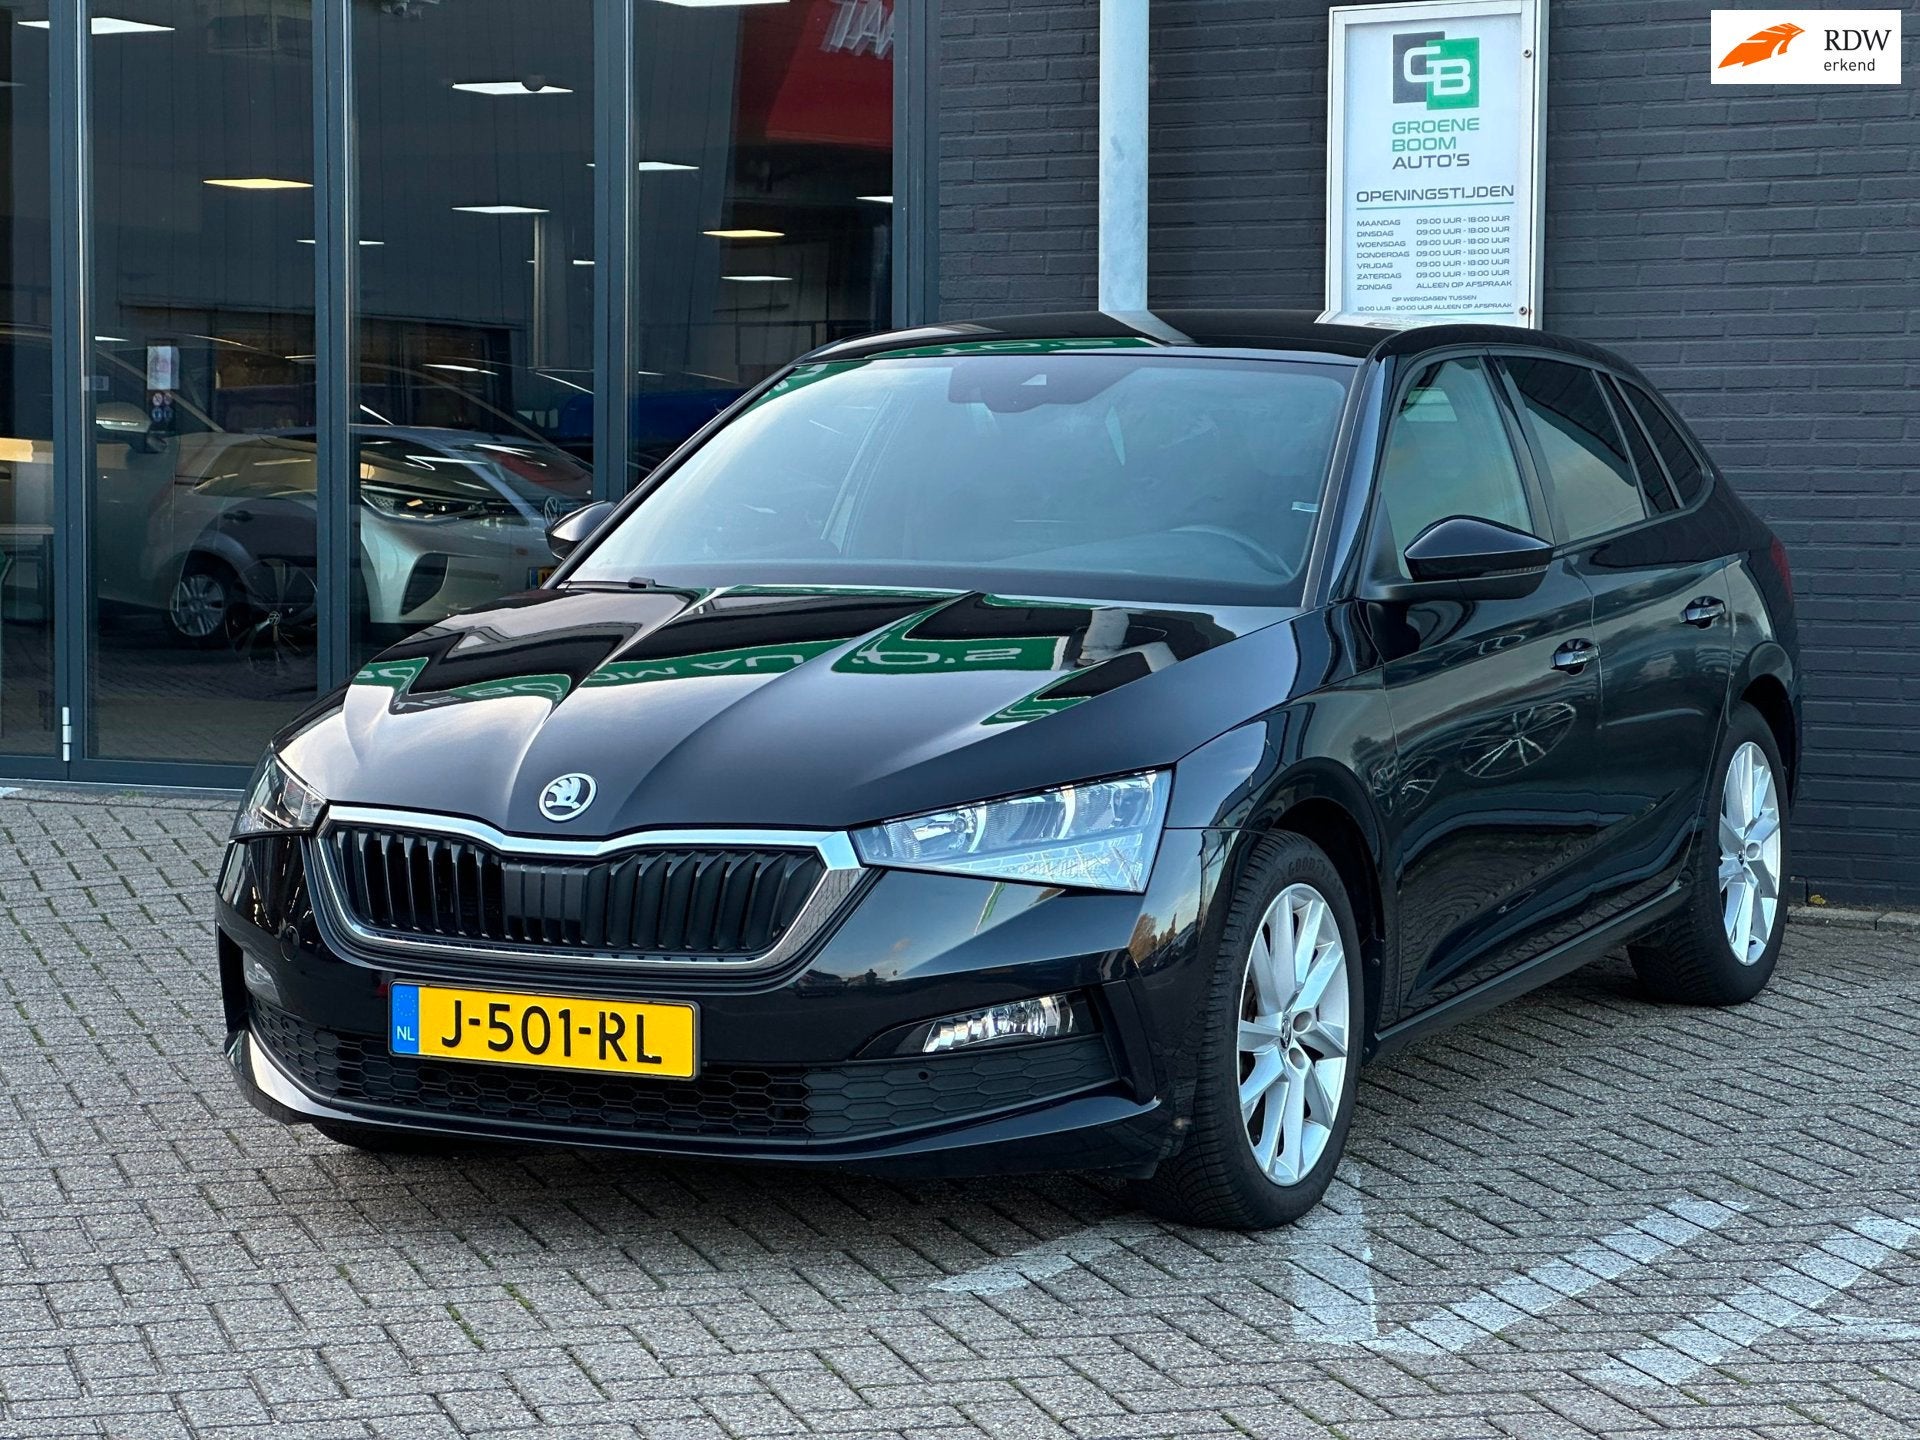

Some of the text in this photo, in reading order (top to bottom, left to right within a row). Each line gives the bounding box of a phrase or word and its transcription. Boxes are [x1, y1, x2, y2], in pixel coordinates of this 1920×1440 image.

[1392, 117, 1480, 135] GROENE
[1392, 136, 1457, 152] BOOM
[1392, 153, 1470, 170] AUTO'S
[1356, 184, 1515, 203] OPENINGSTIJDEN
[1443, 238, 1461, 246] UUR
[1491, 236, 1510, 244] UUR
[1465, 280, 1512, 288] AFSPRAAK
[396, 1000, 662, 1064] NL J-501-RL
